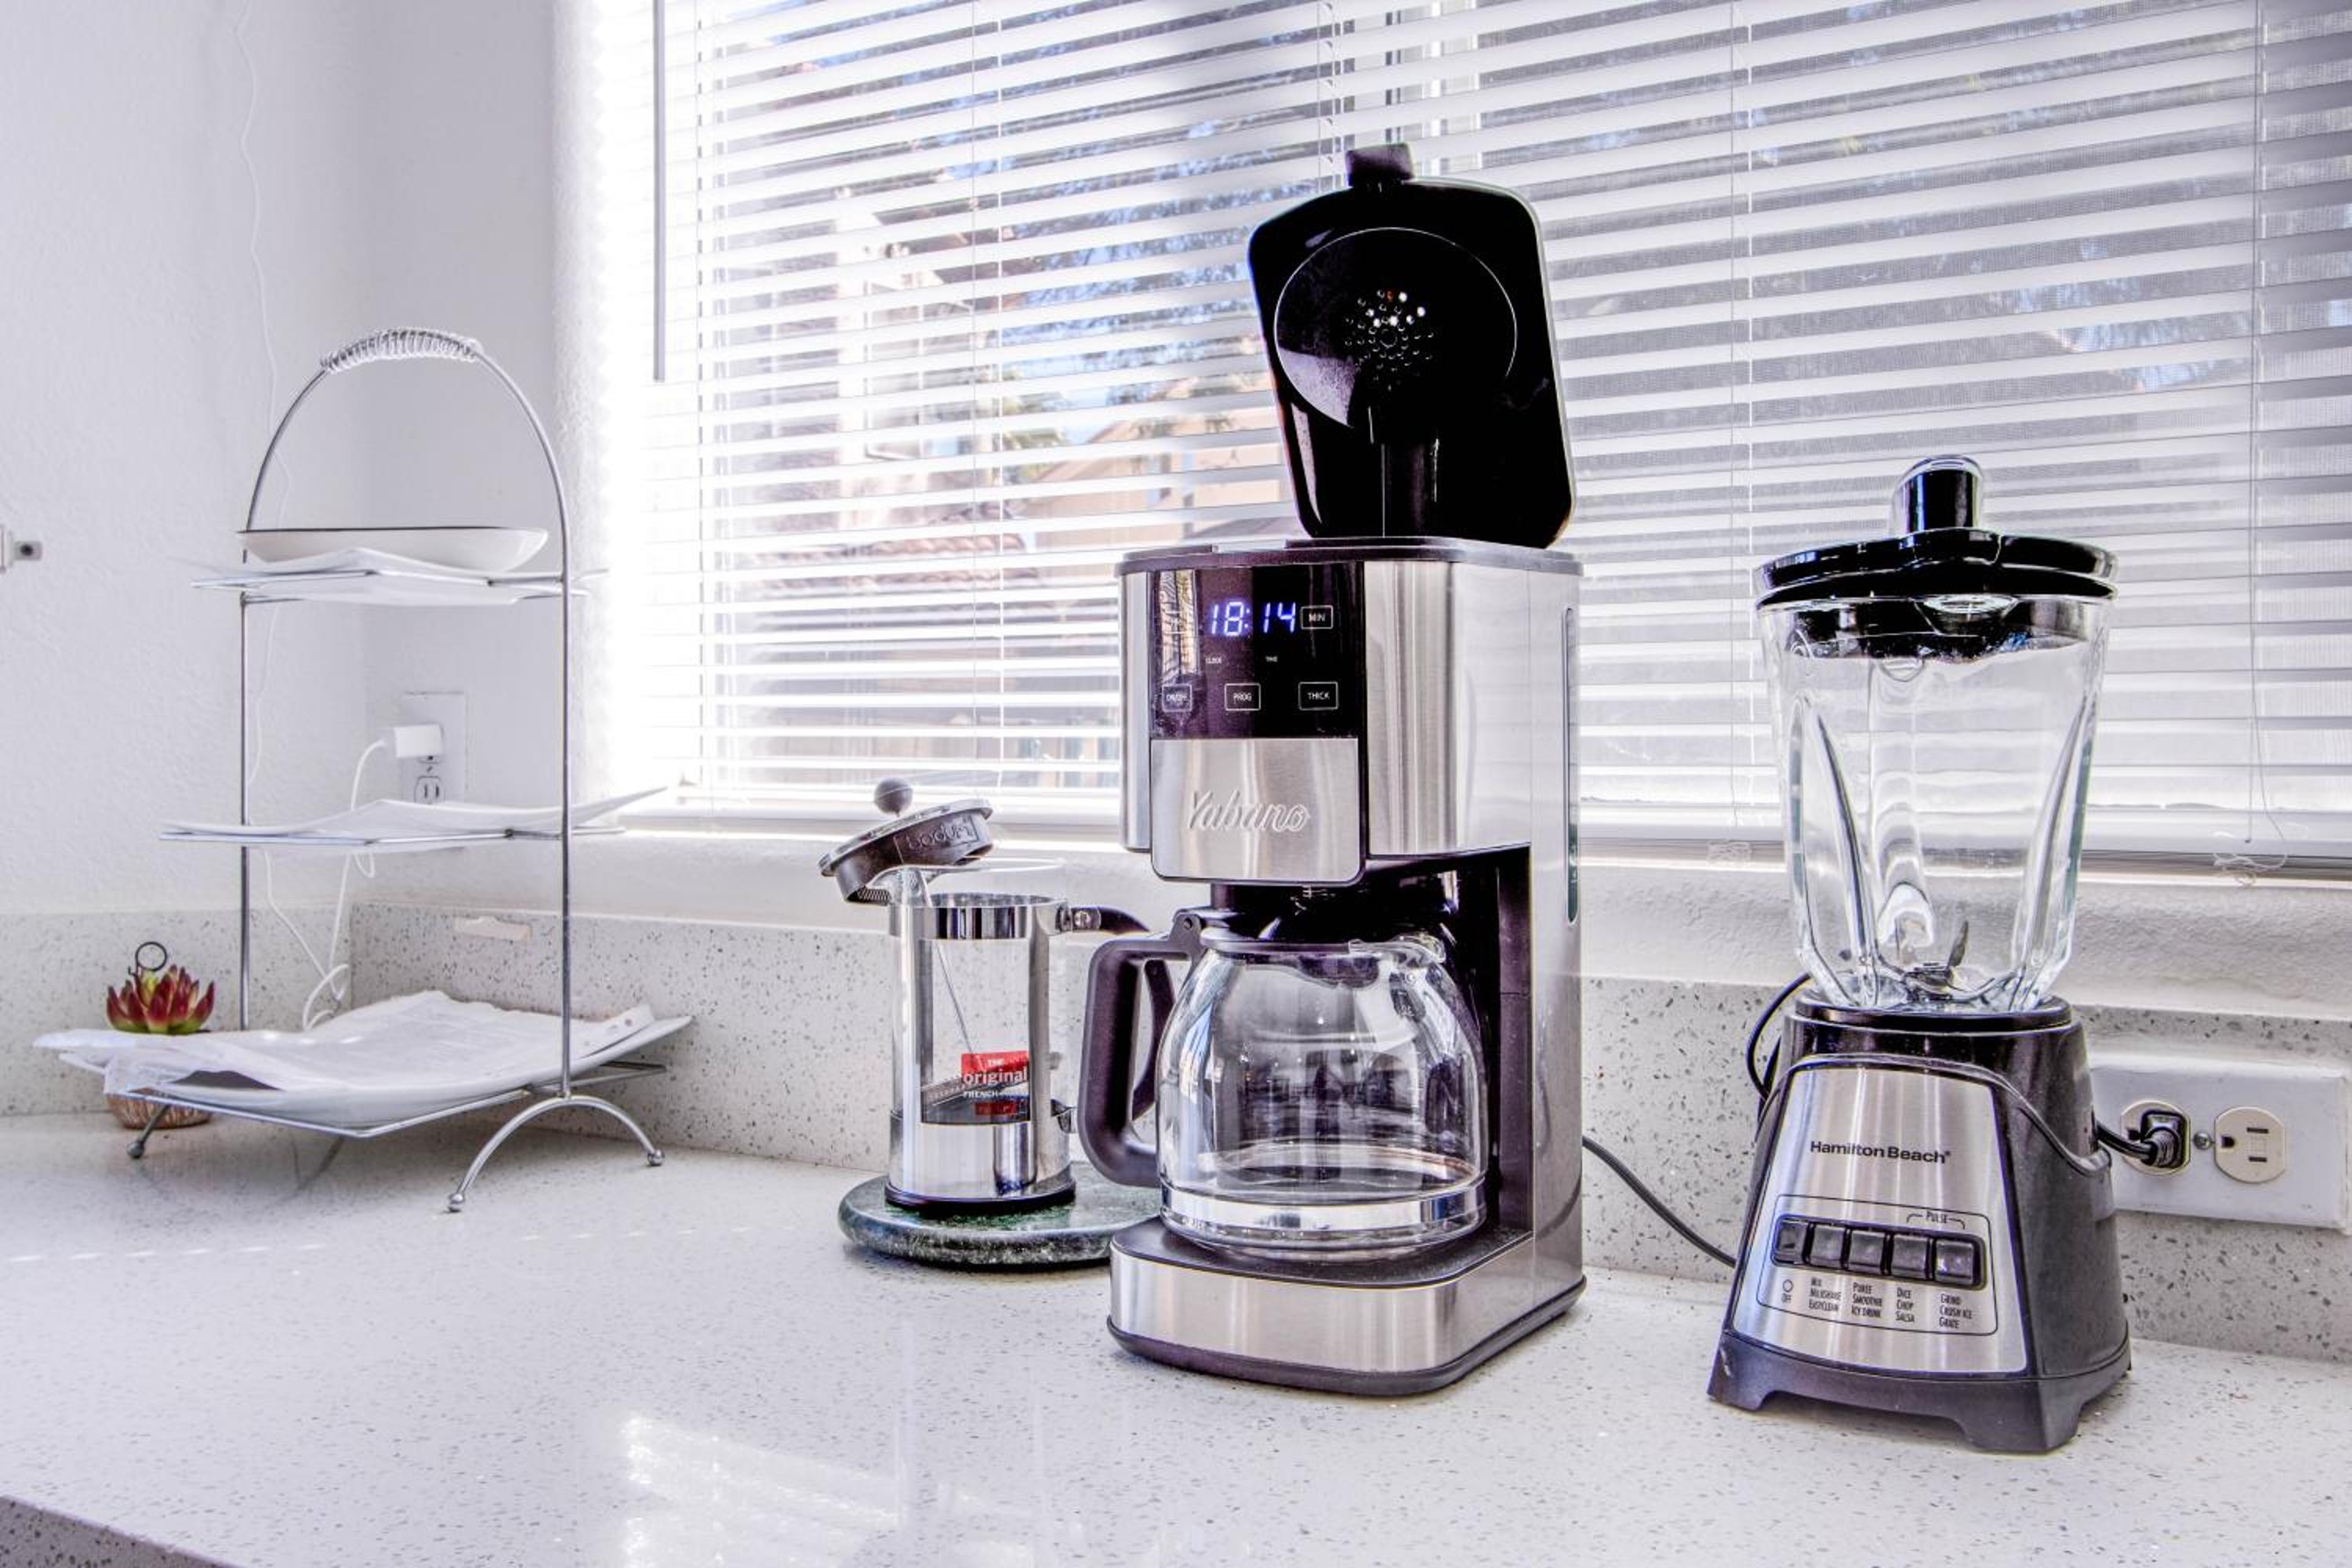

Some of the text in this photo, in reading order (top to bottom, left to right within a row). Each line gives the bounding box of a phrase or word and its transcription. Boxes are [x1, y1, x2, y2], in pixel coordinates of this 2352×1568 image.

[1211, 602, 1296, 636] 18:14
[1232, 692, 1252, 702] PROG
[1307, 691, 1330, 701] THICK
[963, 1066, 1028, 1085] original
[1810, 1141, 1885, 1157] Hamilton
